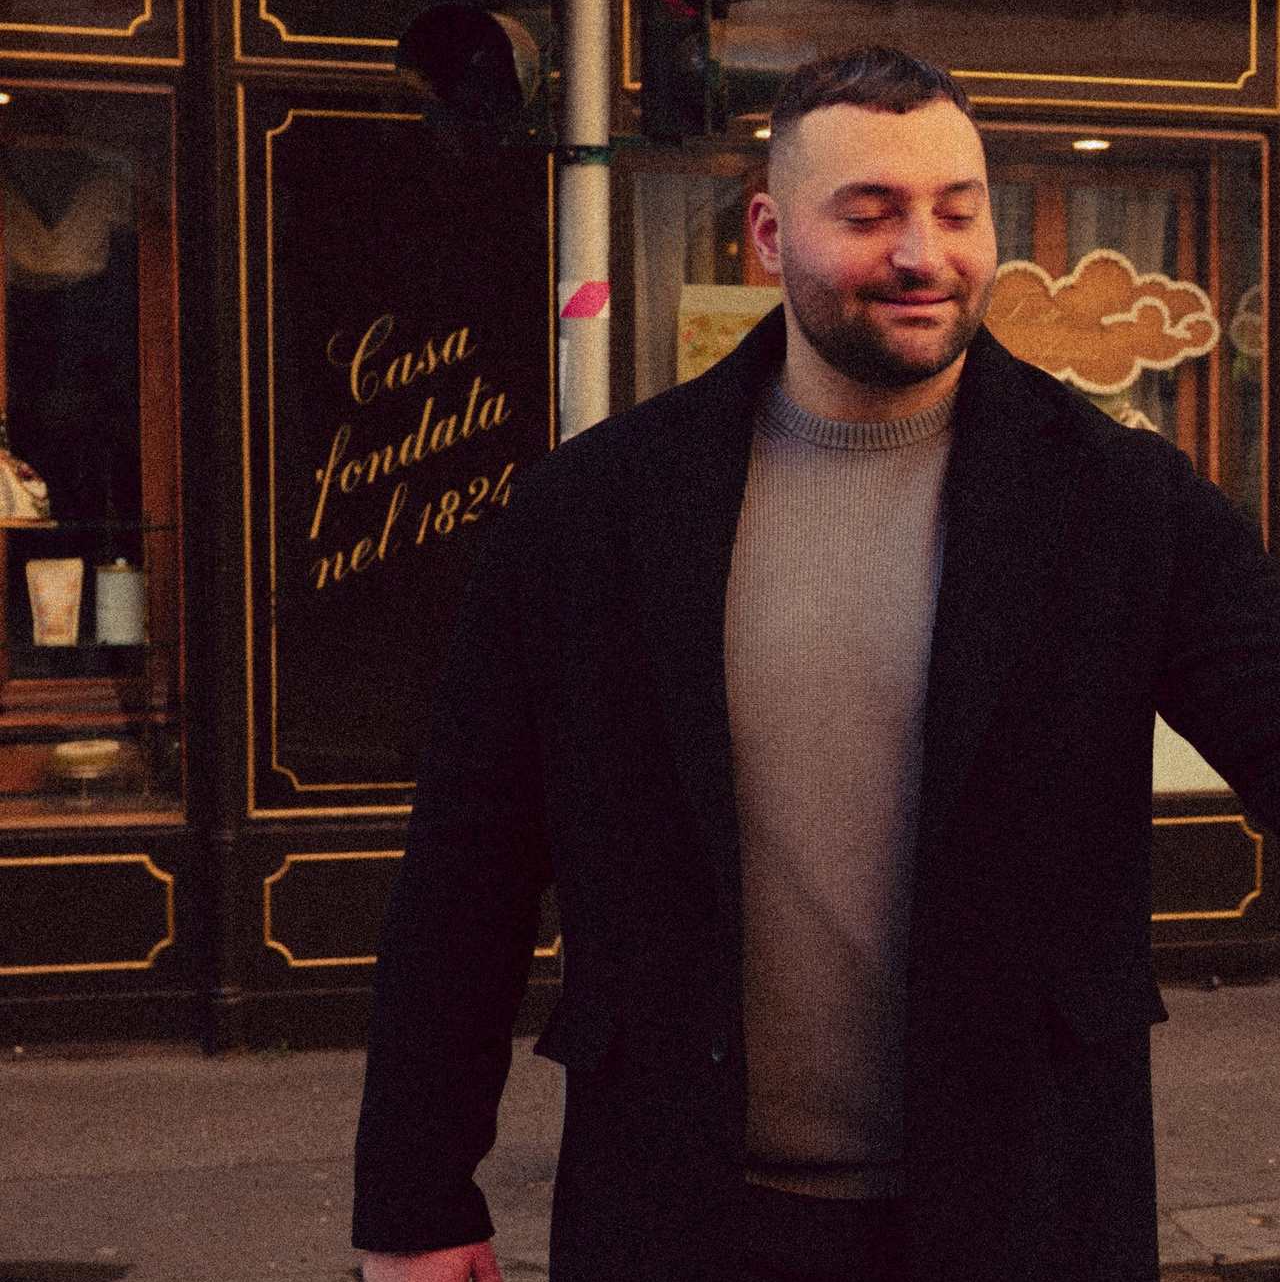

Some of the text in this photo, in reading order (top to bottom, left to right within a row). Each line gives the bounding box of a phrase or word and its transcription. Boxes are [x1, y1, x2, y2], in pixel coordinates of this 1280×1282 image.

[327, 313, 478, 405] Casa
[309, 376, 512, 541] fondata
[309, 462, 515, 590] nel 1824
